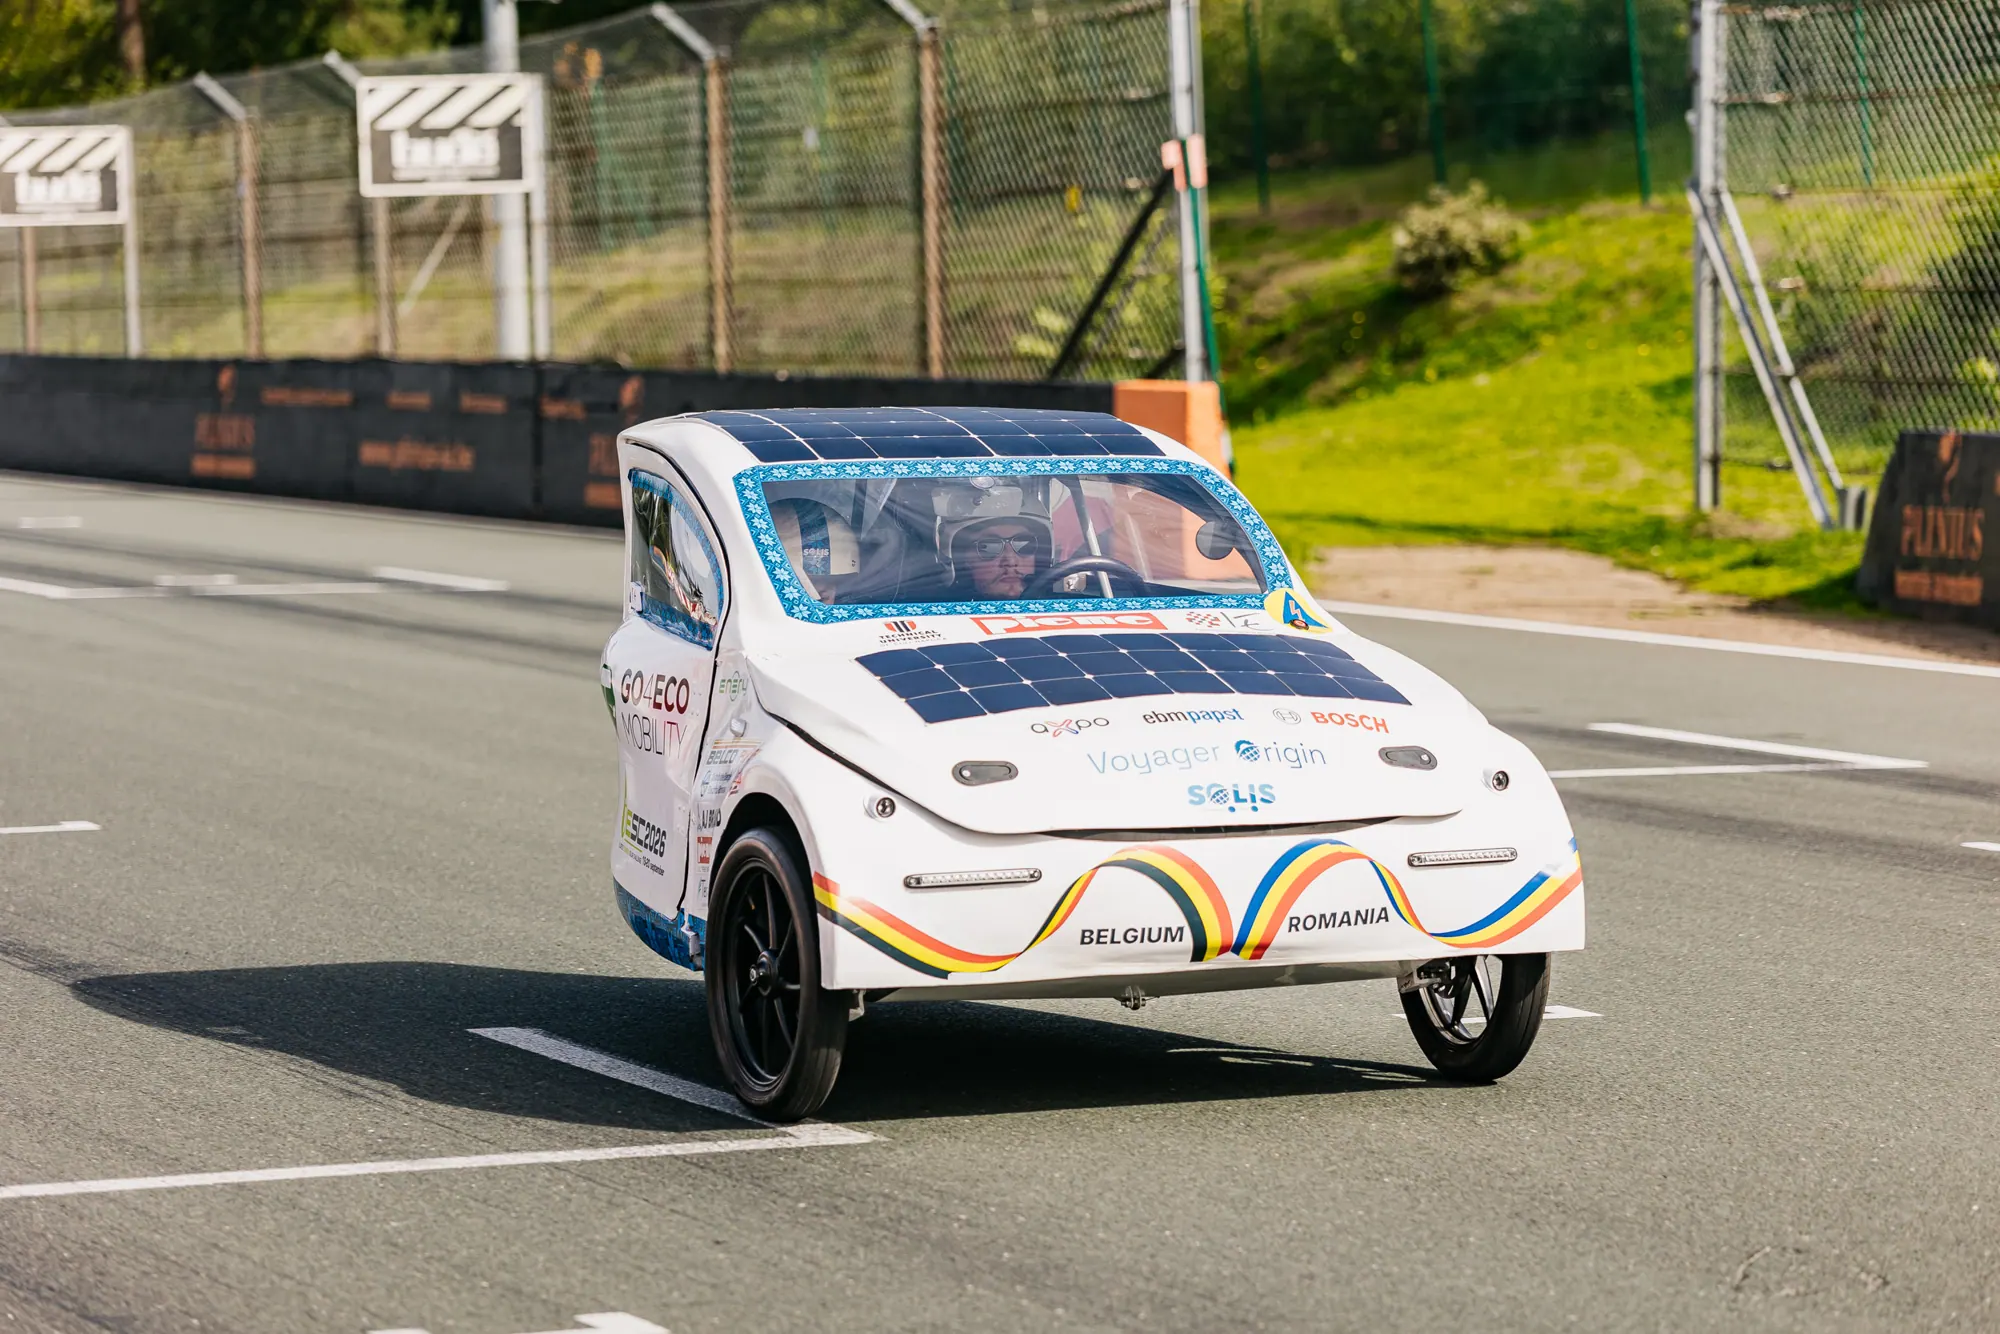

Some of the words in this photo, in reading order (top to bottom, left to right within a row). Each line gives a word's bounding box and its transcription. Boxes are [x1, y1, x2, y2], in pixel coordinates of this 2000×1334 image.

[879, 630, 939, 640] TECHNICAL
[880, 634, 941, 644] UNIVERSITY
[621, 668, 690, 715] GO4ECO
[1030, 716, 1110, 738] axpo
[1142, 707, 1244, 725] ebmpapst
[1310, 711, 1390, 734] BOSCH
[621, 711, 688, 759] MOBILITY
[1086, 743, 1220, 775] Voyager
[1234, 739, 1327, 769] Origin
[1187, 782, 1276, 812] SOLIS
[1288, 906, 1390, 933] ROMANIA
[1080, 926, 1185, 945] BELGIUM
